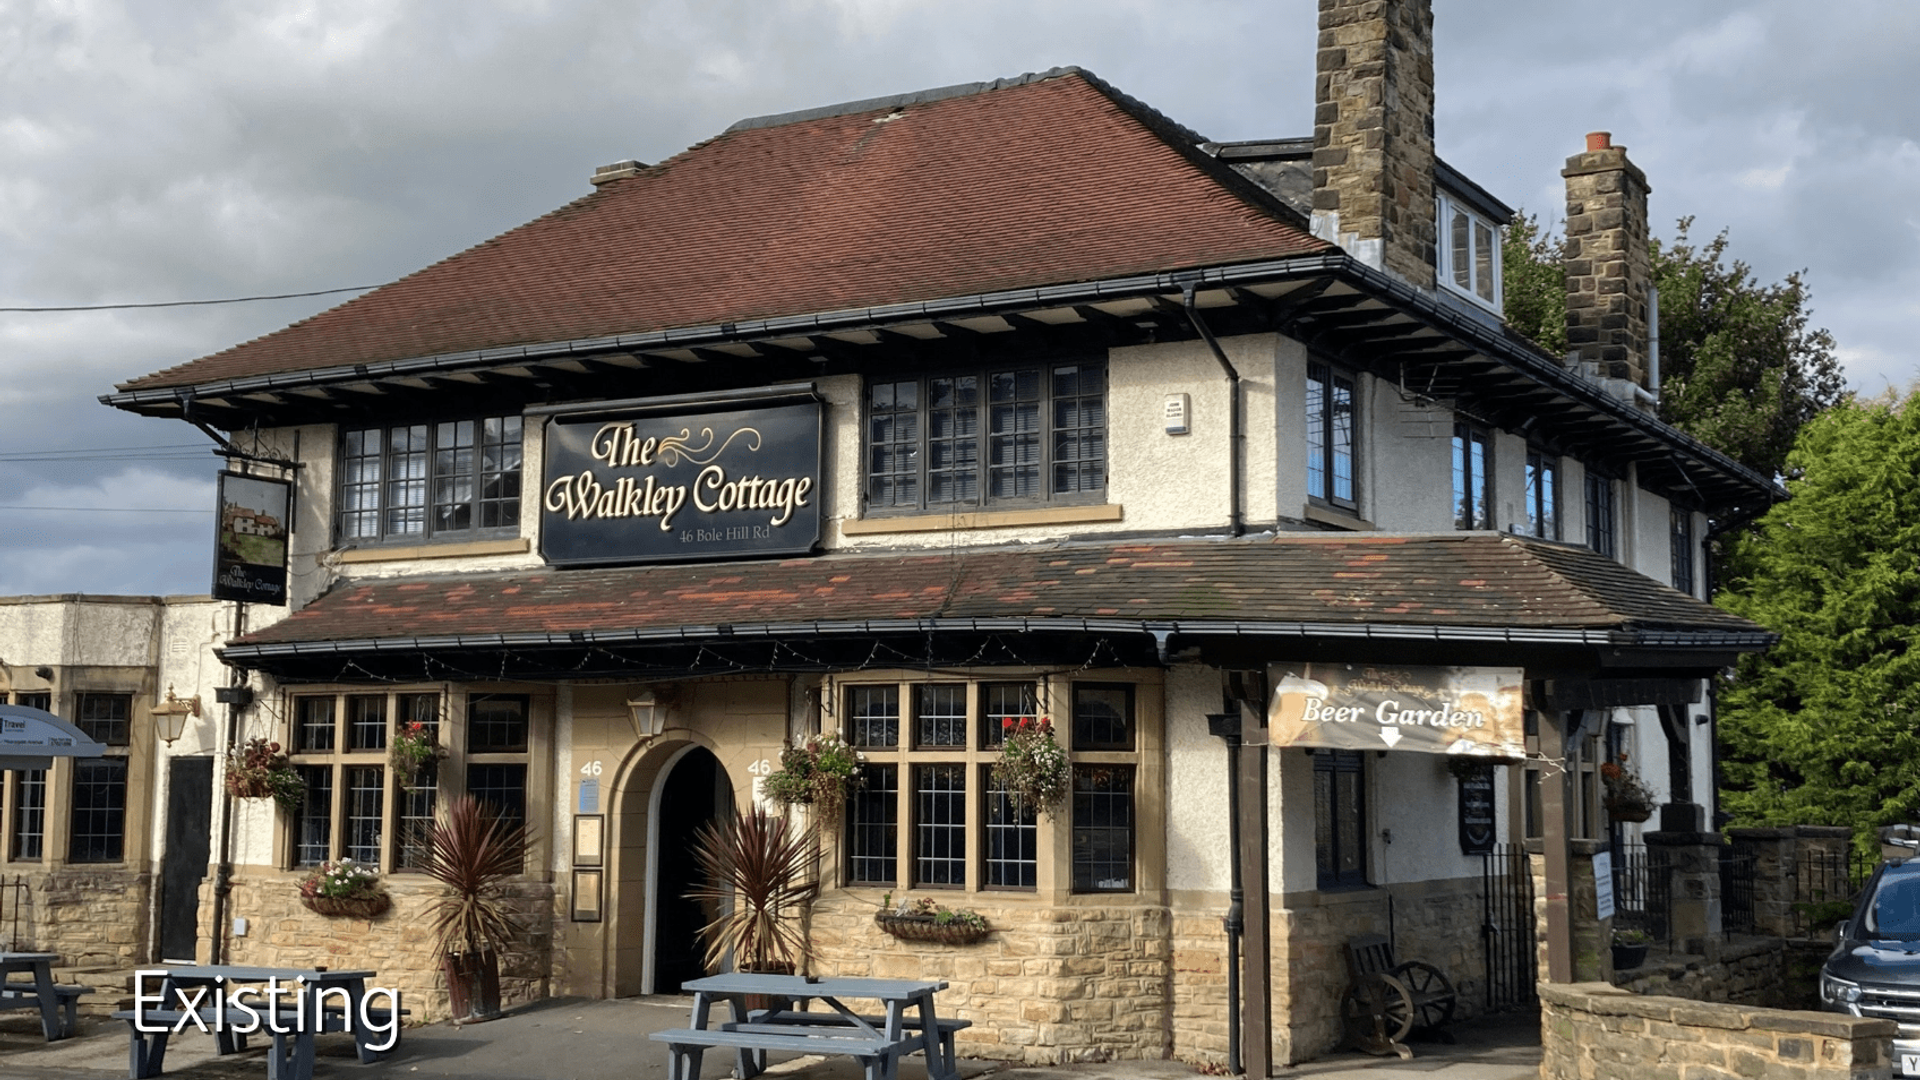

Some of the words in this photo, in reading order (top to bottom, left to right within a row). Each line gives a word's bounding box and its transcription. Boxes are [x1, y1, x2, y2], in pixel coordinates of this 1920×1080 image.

[591, 421, 656, 467] The
[546, 470, 687, 531] Walkley
[693, 465, 812, 526] Cottage
[680, 530, 694, 543] 46
[697, 527, 723, 542] Bole
[726, 526, 749, 540] Hill
[753, 524, 770, 539] Rd
[1301, 696, 1365, 723] Beer
[1375, 700, 1485, 728] Garden
[580, 761, 602, 776] 46
[747, 759, 771, 775] 46
[1909, 1057, 1920, 1071] Y
